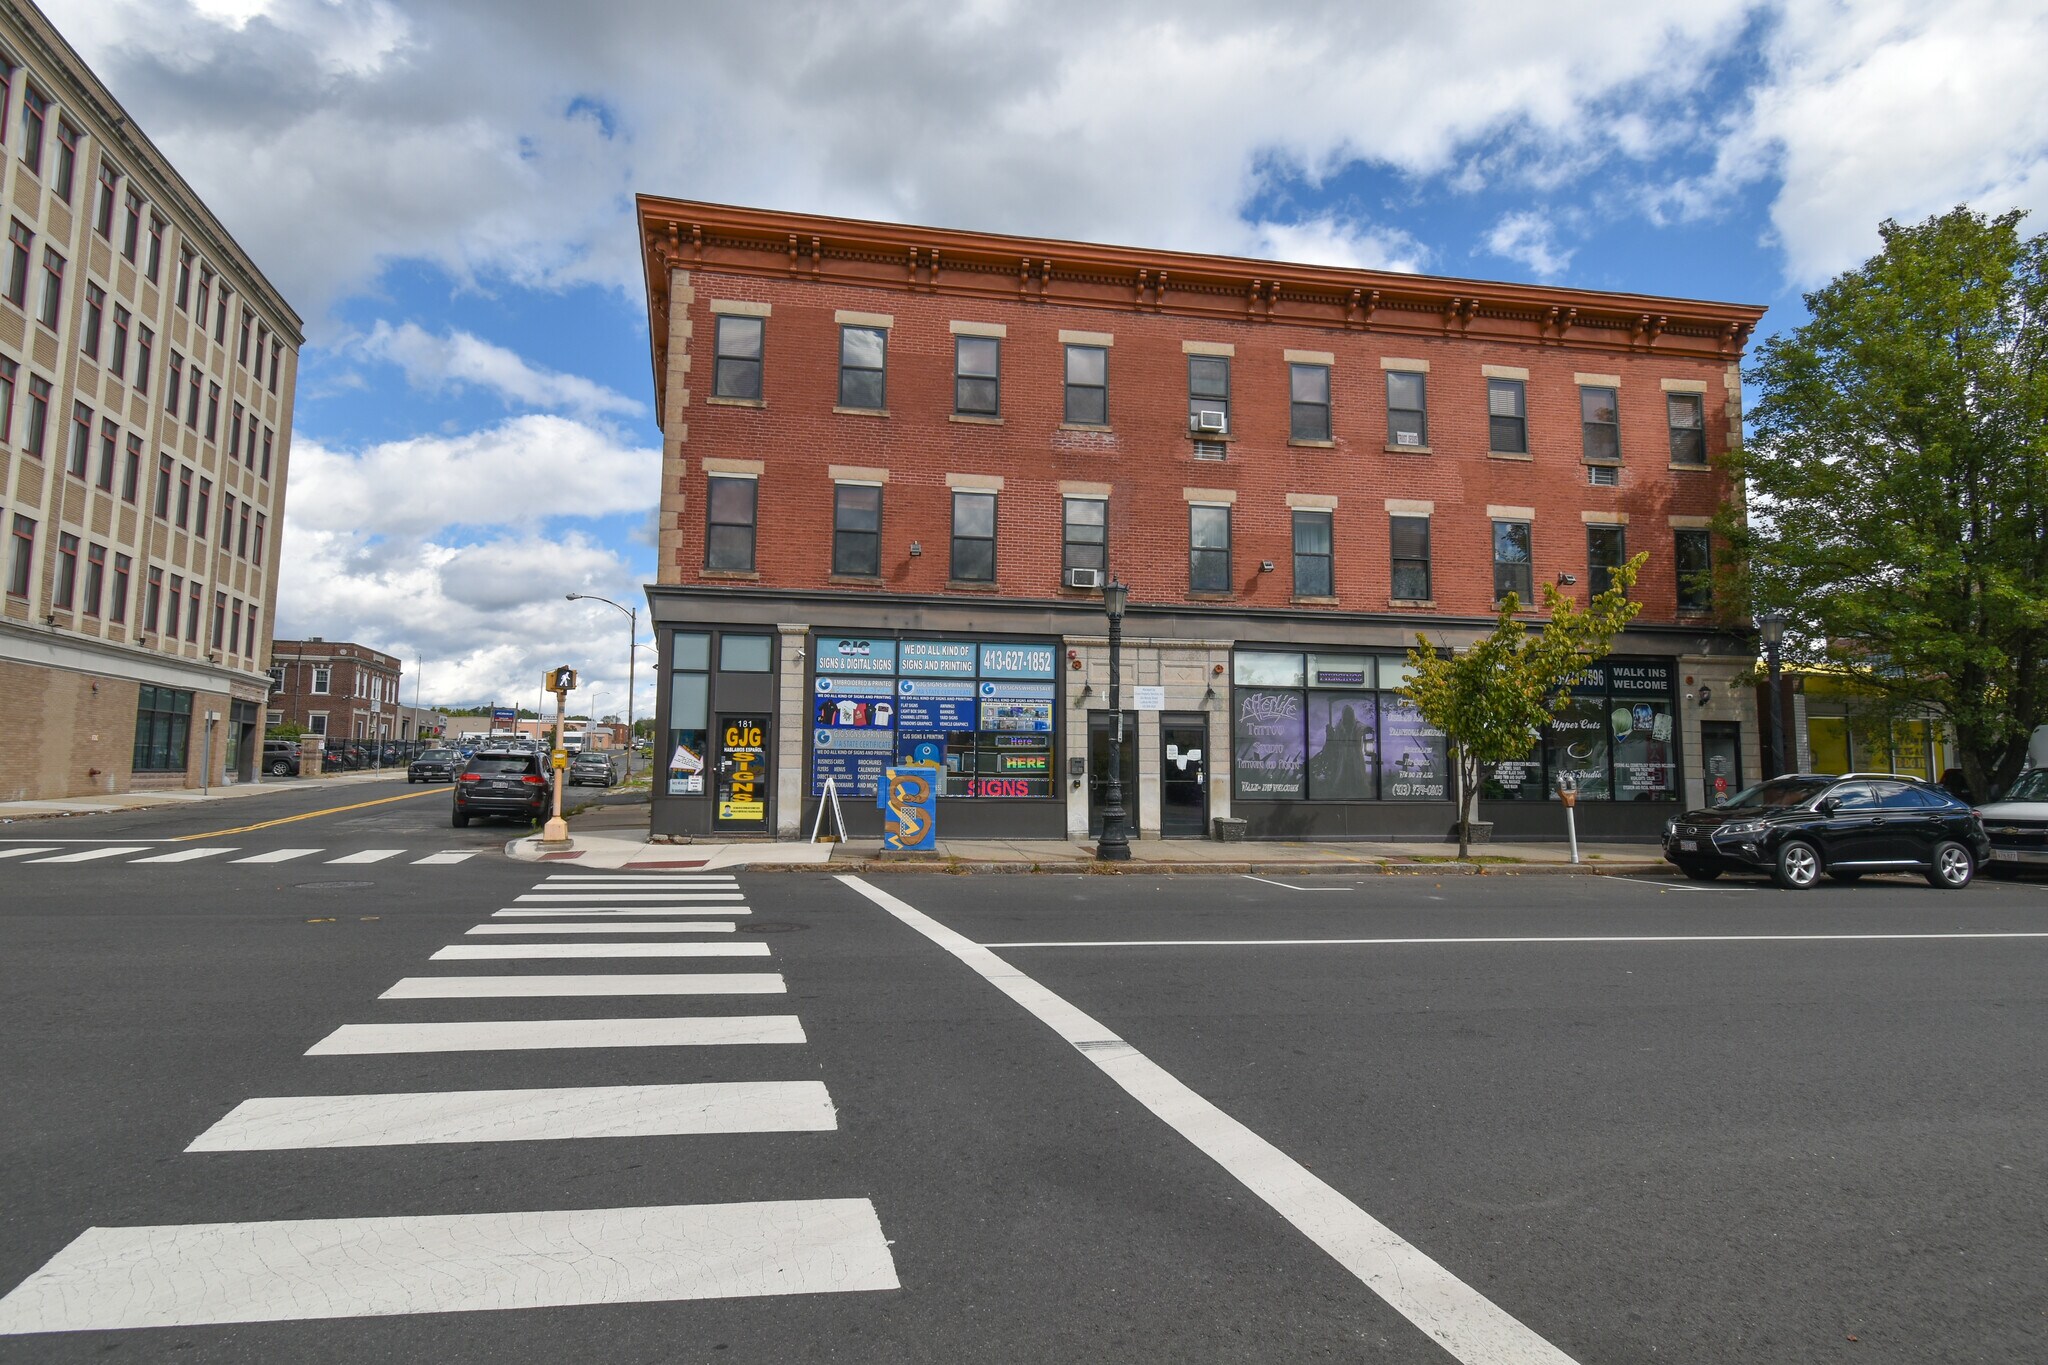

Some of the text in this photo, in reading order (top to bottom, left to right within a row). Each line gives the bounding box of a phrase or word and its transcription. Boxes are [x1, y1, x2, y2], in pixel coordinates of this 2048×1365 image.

[838, 640, 870, 656] GJG
[904, 644, 969, 656] WE DO ALL KIND OF
[820, 658, 892, 670] SIGNS & DIGITAL SIGNS
[902, 660, 972, 672] SIGNS AND PRINTING
[984, 650, 1050, 672] 413-627-1852
[1613, 668, 1666, 678] WALK INS
[1614, 680, 1668, 690] WELCOME
[1552, 718, 1600, 732] Upper Cuts
[726, 728, 761, 747] GJG
[1010, 736, 1032, 746] Here
[1006, 757, 1046, 768] HERE
[1576, 768, 1602, 778] Studio
[968, 780, 1028, 798] SIGNS
